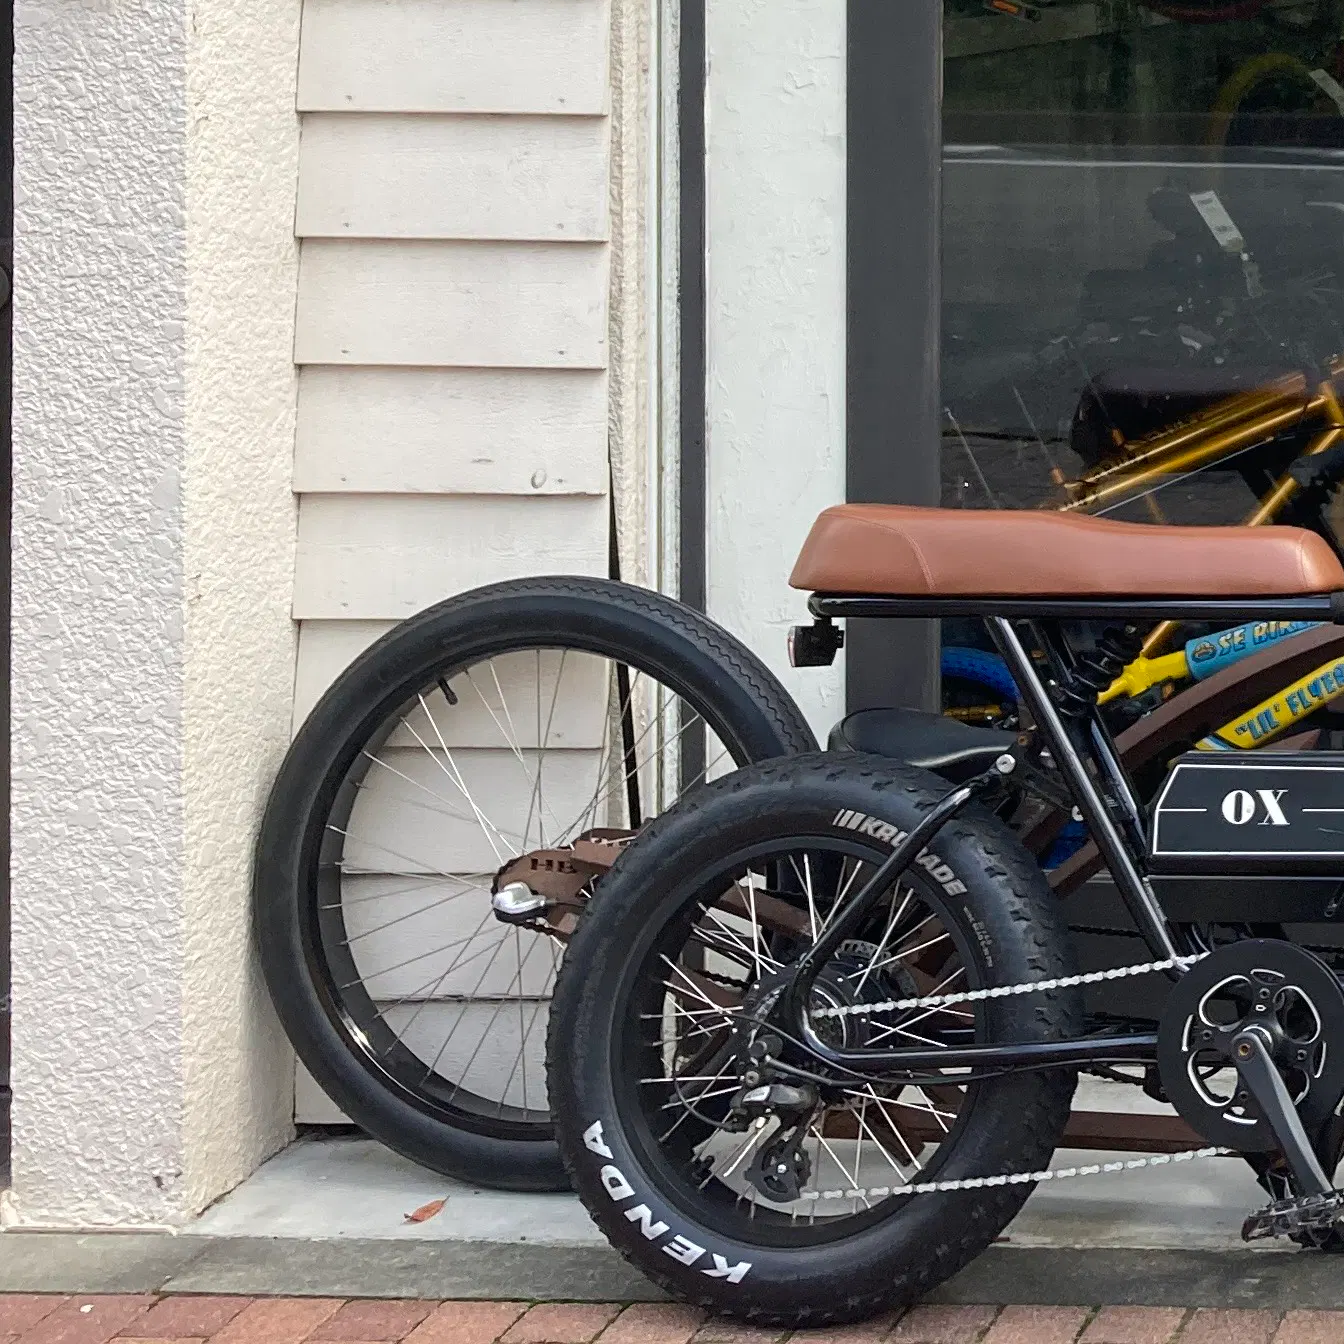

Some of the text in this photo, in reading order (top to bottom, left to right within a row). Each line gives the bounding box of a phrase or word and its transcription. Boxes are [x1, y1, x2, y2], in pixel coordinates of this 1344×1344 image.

[1217, 627, 1247, 656] SE
[1221, 788, 1291, 826] OX
[860, 813, 969, 898] KRUADE
[581, 1119, 753, 1285] KENDA
